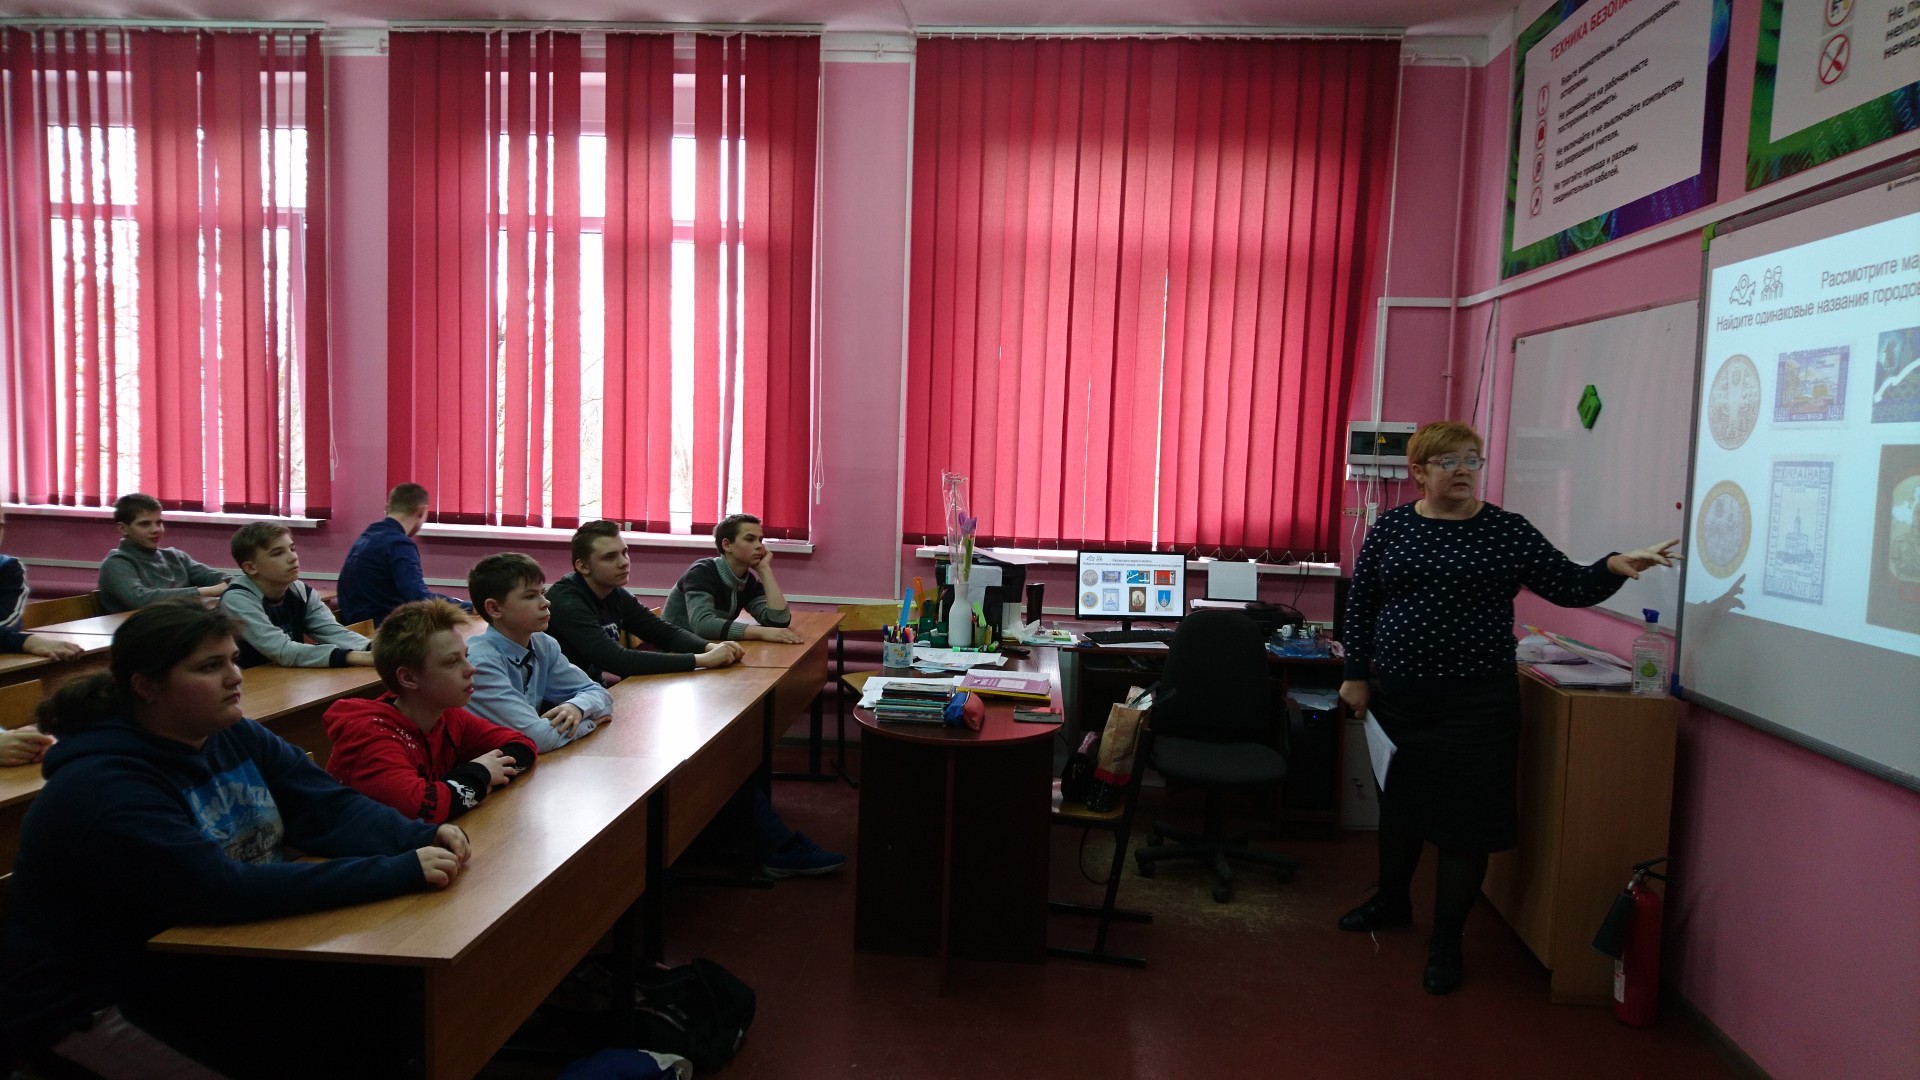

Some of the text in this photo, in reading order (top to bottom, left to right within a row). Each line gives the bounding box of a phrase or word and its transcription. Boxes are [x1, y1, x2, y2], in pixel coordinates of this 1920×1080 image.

[1888, 6, 1904, 23] Не
[1550, 21, 1588, 62] ТЕХНИКА
[1558, 58, 1649, 121] Не размещайте на рабочем месте
[1556, 147, 1562, 156] Не
[1563, 131, 1590, 153] включайте
[1596, 125, 1603, 133] не
[1603, 102, 1641, 129] выключайте
[1641, 77, 1684, 108] компьютеры
[1554, 182, 1560, 191] Не
[1560, 171, 1582, 188] трогайте
[1583, 159, 1605, 176] провода
[1611, 142, 1638, 164] разъемы
[1555, 160, 1563, 170] без
[1564, 143, 1594, 167] разрешения
[1821, 254, 1920, 289] Рассмотрите ма
[1717, 314, 1753, 332] Найдите
[1755, 302, 1814, 326] одинаковые
[1816, 291, 1869, 314] названия
